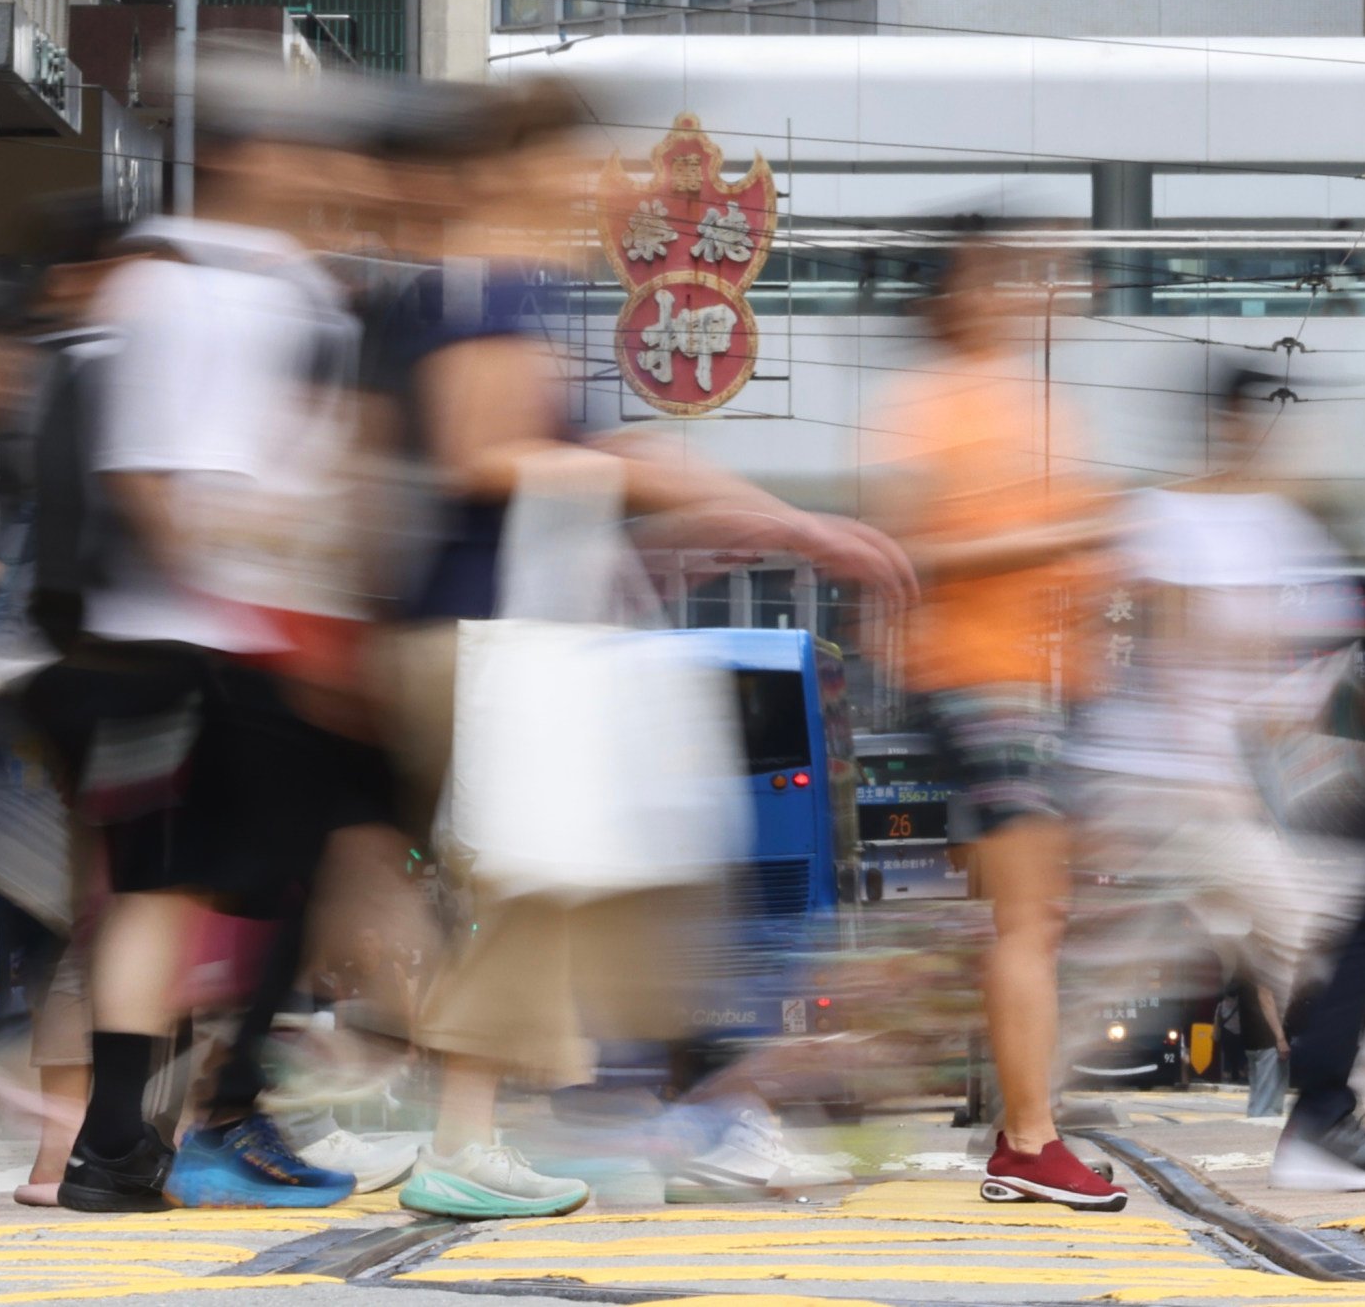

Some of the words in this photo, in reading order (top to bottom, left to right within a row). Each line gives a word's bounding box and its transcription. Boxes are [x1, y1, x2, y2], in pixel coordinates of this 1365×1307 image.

[636, 288, 738, 393] 押
[888, 813, 912, 838] 26
[691, 1009, 757, 1025] Citybus
